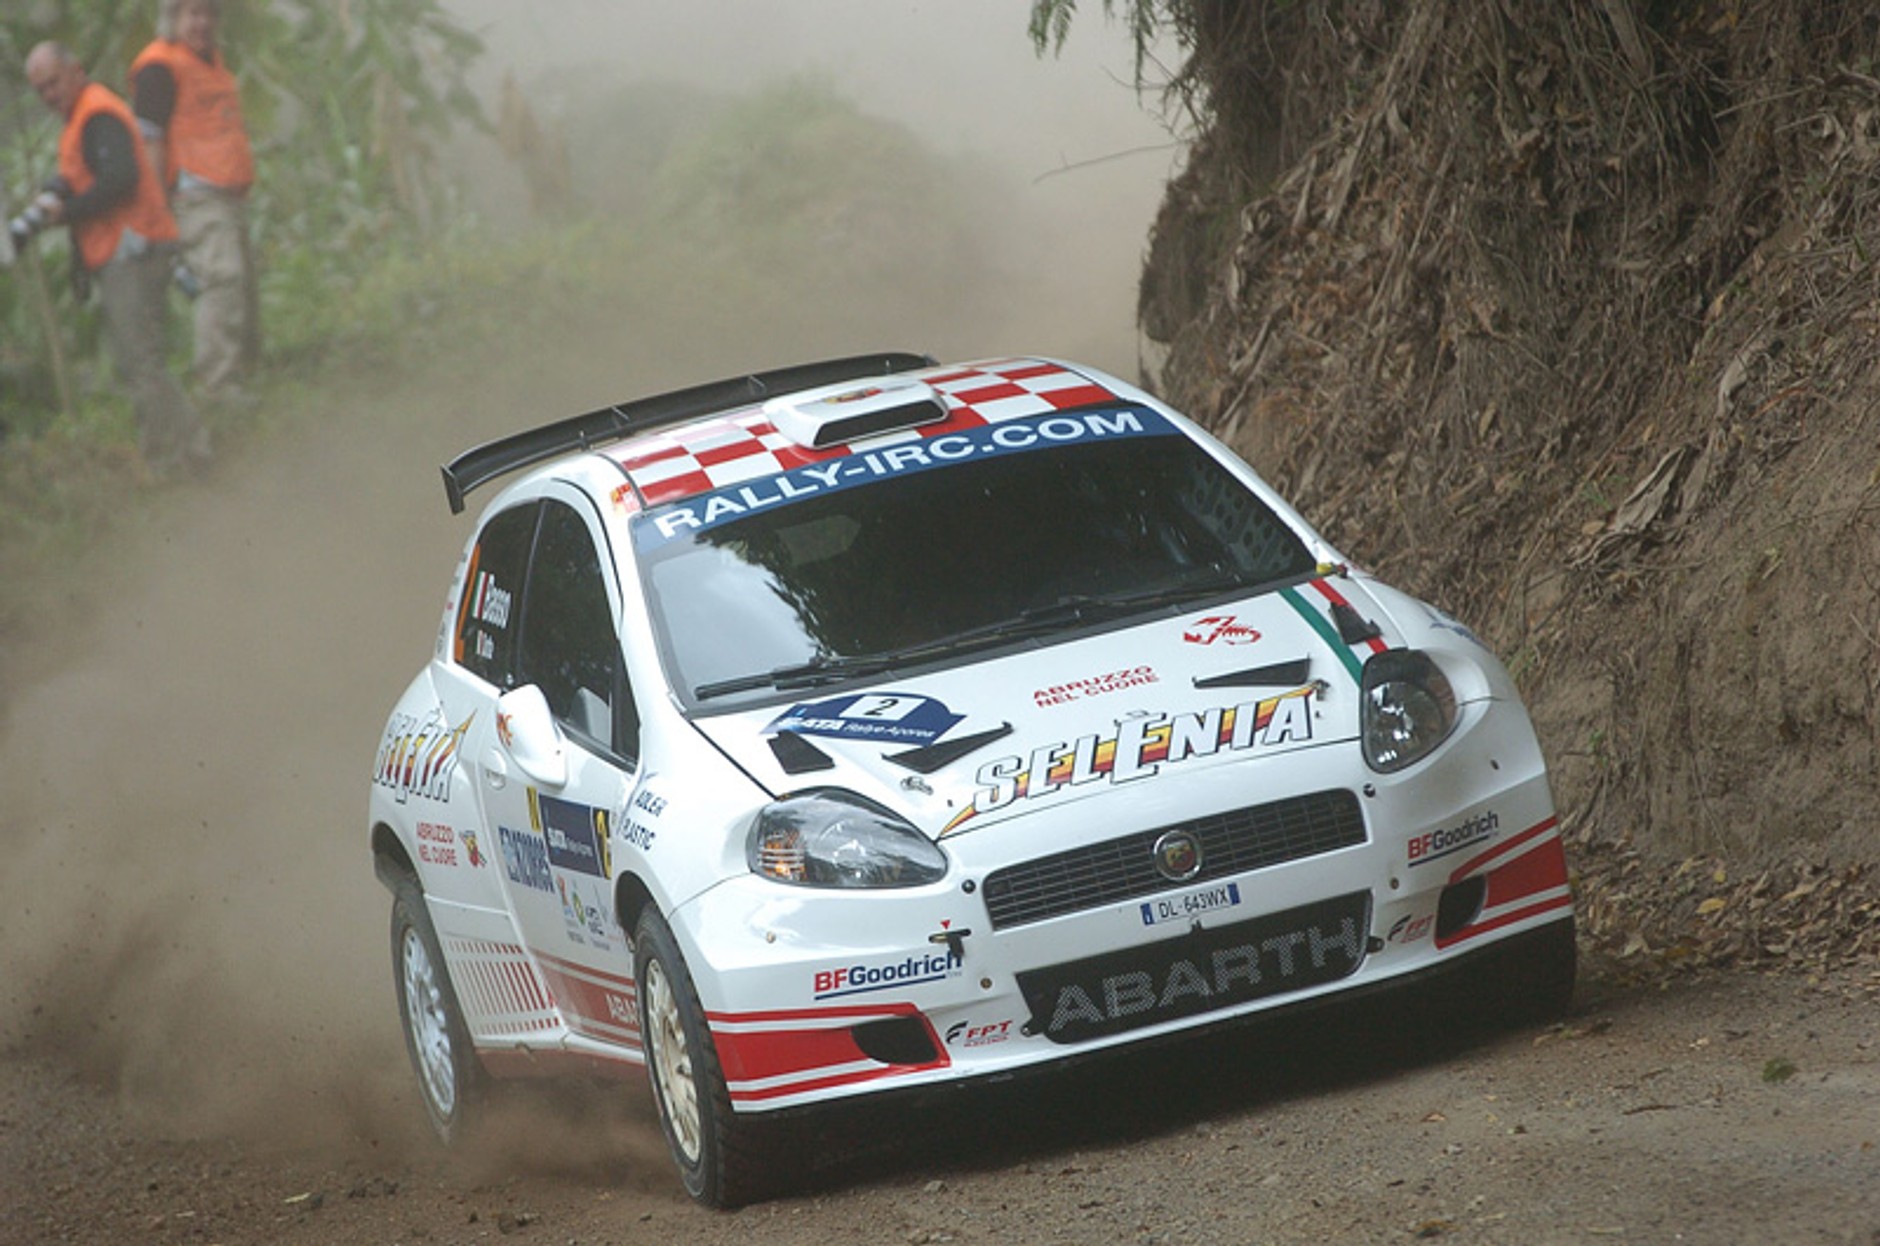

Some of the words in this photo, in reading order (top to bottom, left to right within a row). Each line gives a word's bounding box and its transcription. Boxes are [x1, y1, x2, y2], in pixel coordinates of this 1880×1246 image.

[653, 410, 1147, 540] RALLY-IRC.COM
[1033, 665, 1153, 700] ABRUZZO
[1036, 693, 1079, 708] NEL
[1084, 674, 1160, 698] CUORE
[863, 698, 899, 717] 2
[416, 821, 455, 844] ABRUZZO
[1407, 810, 1499, 860] BFGoodrich
[814, 950, 963, 993] BFGoodrich
[1049, 916, 1360, 1032] ABARTH
[966, 1019, 1014, 1038] FPT
